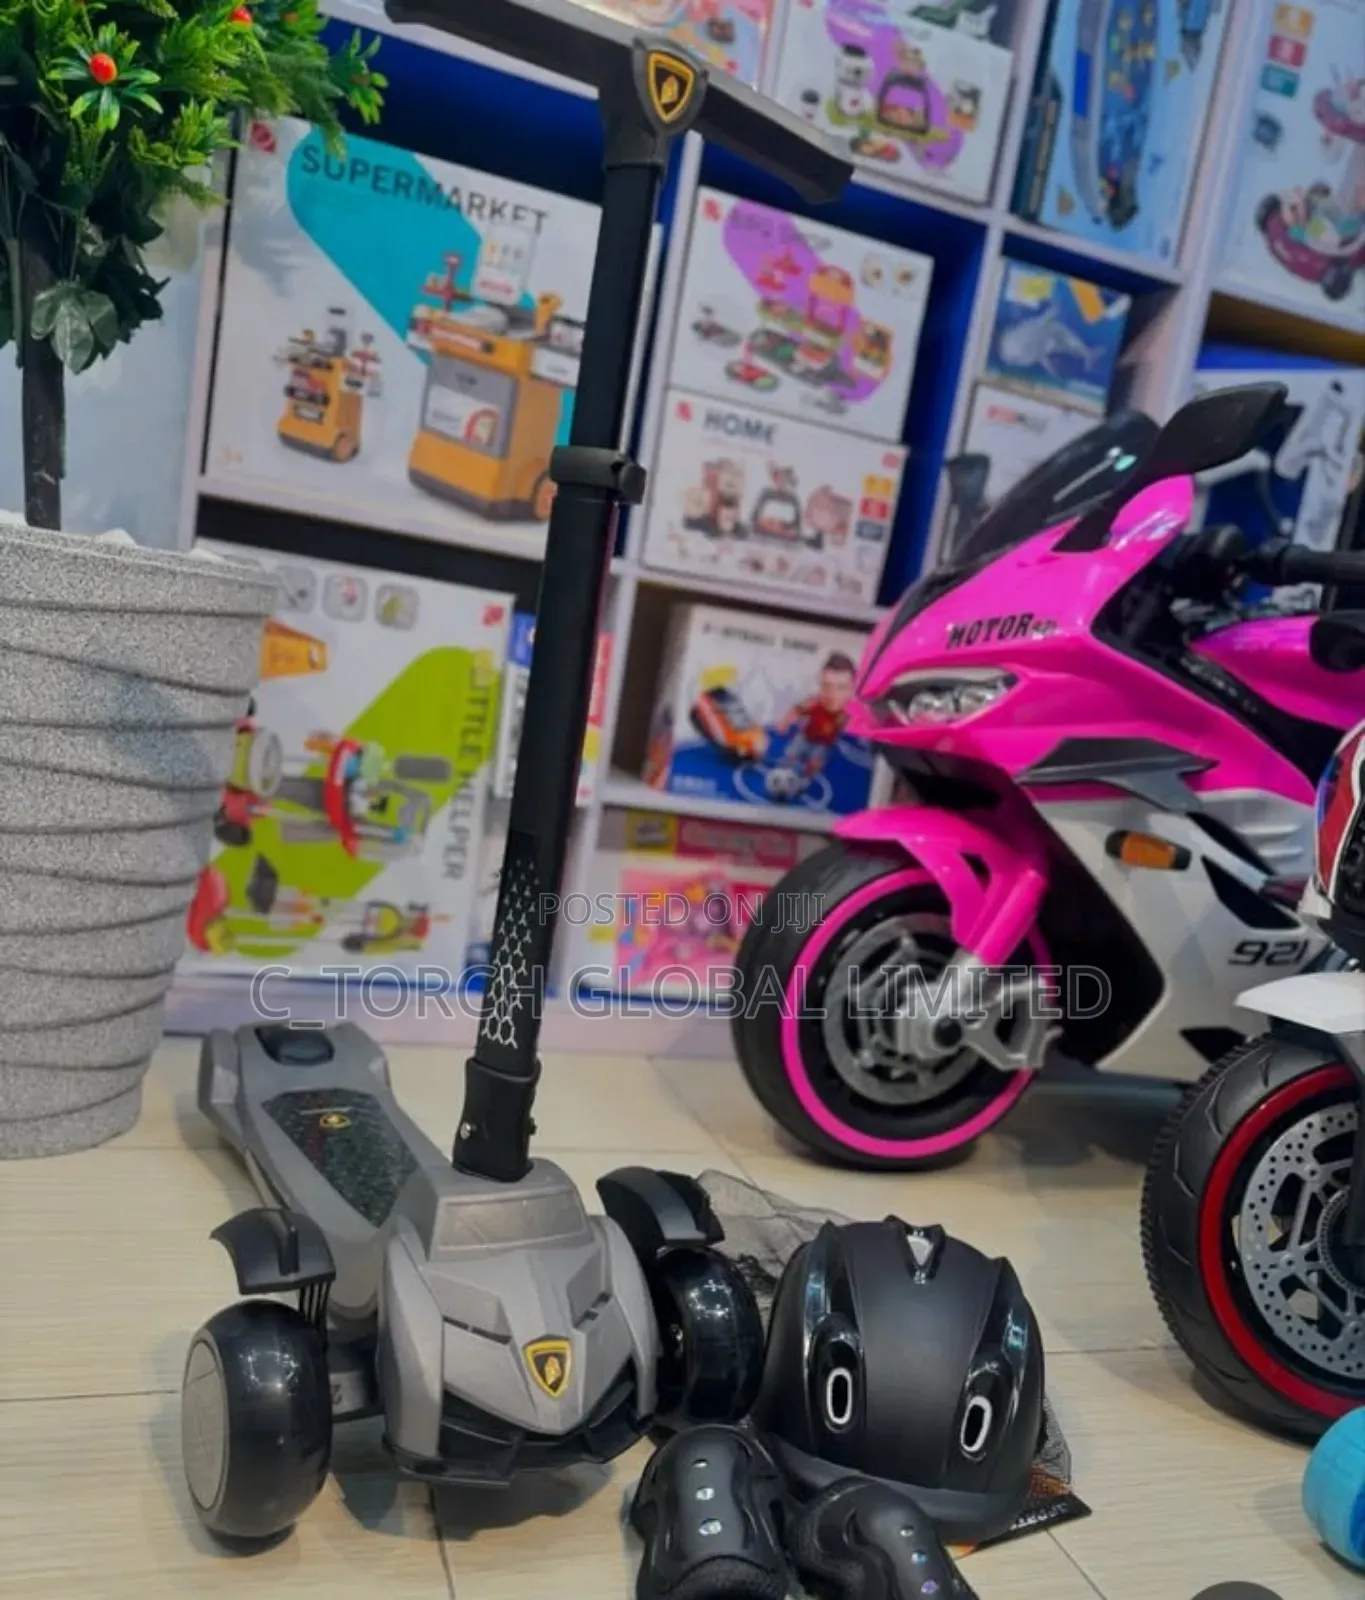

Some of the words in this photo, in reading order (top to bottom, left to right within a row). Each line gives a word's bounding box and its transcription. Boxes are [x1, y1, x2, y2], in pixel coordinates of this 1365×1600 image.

[300, 144, 549, 236] SUPERMARKET
[945, 612, 1034, 650] MOTOR
[1228, 940, 1309, 966] 921
